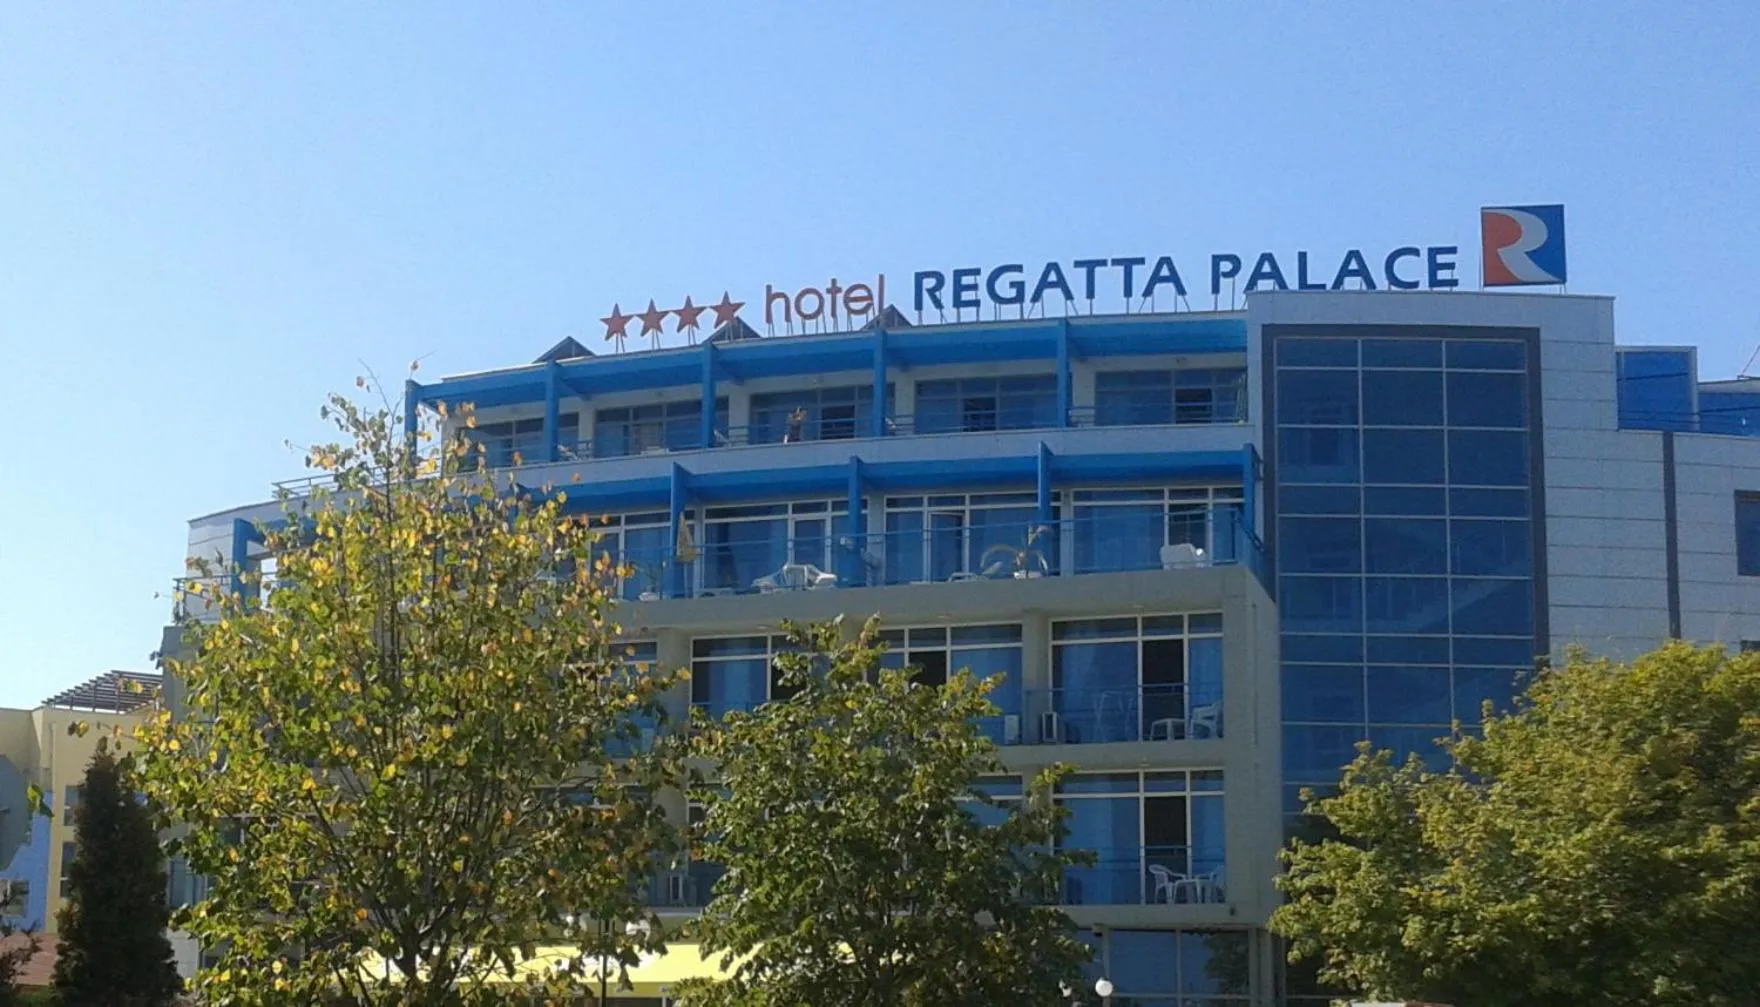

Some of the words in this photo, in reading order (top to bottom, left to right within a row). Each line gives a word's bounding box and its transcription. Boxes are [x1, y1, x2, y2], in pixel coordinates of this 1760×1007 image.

[765, 273, 885, 324] hotel
[913, 256, 1188, 311] REGATTA
[1211, 246, 1459, 294] PALACE
[1482, 207, 1560, 285] R
